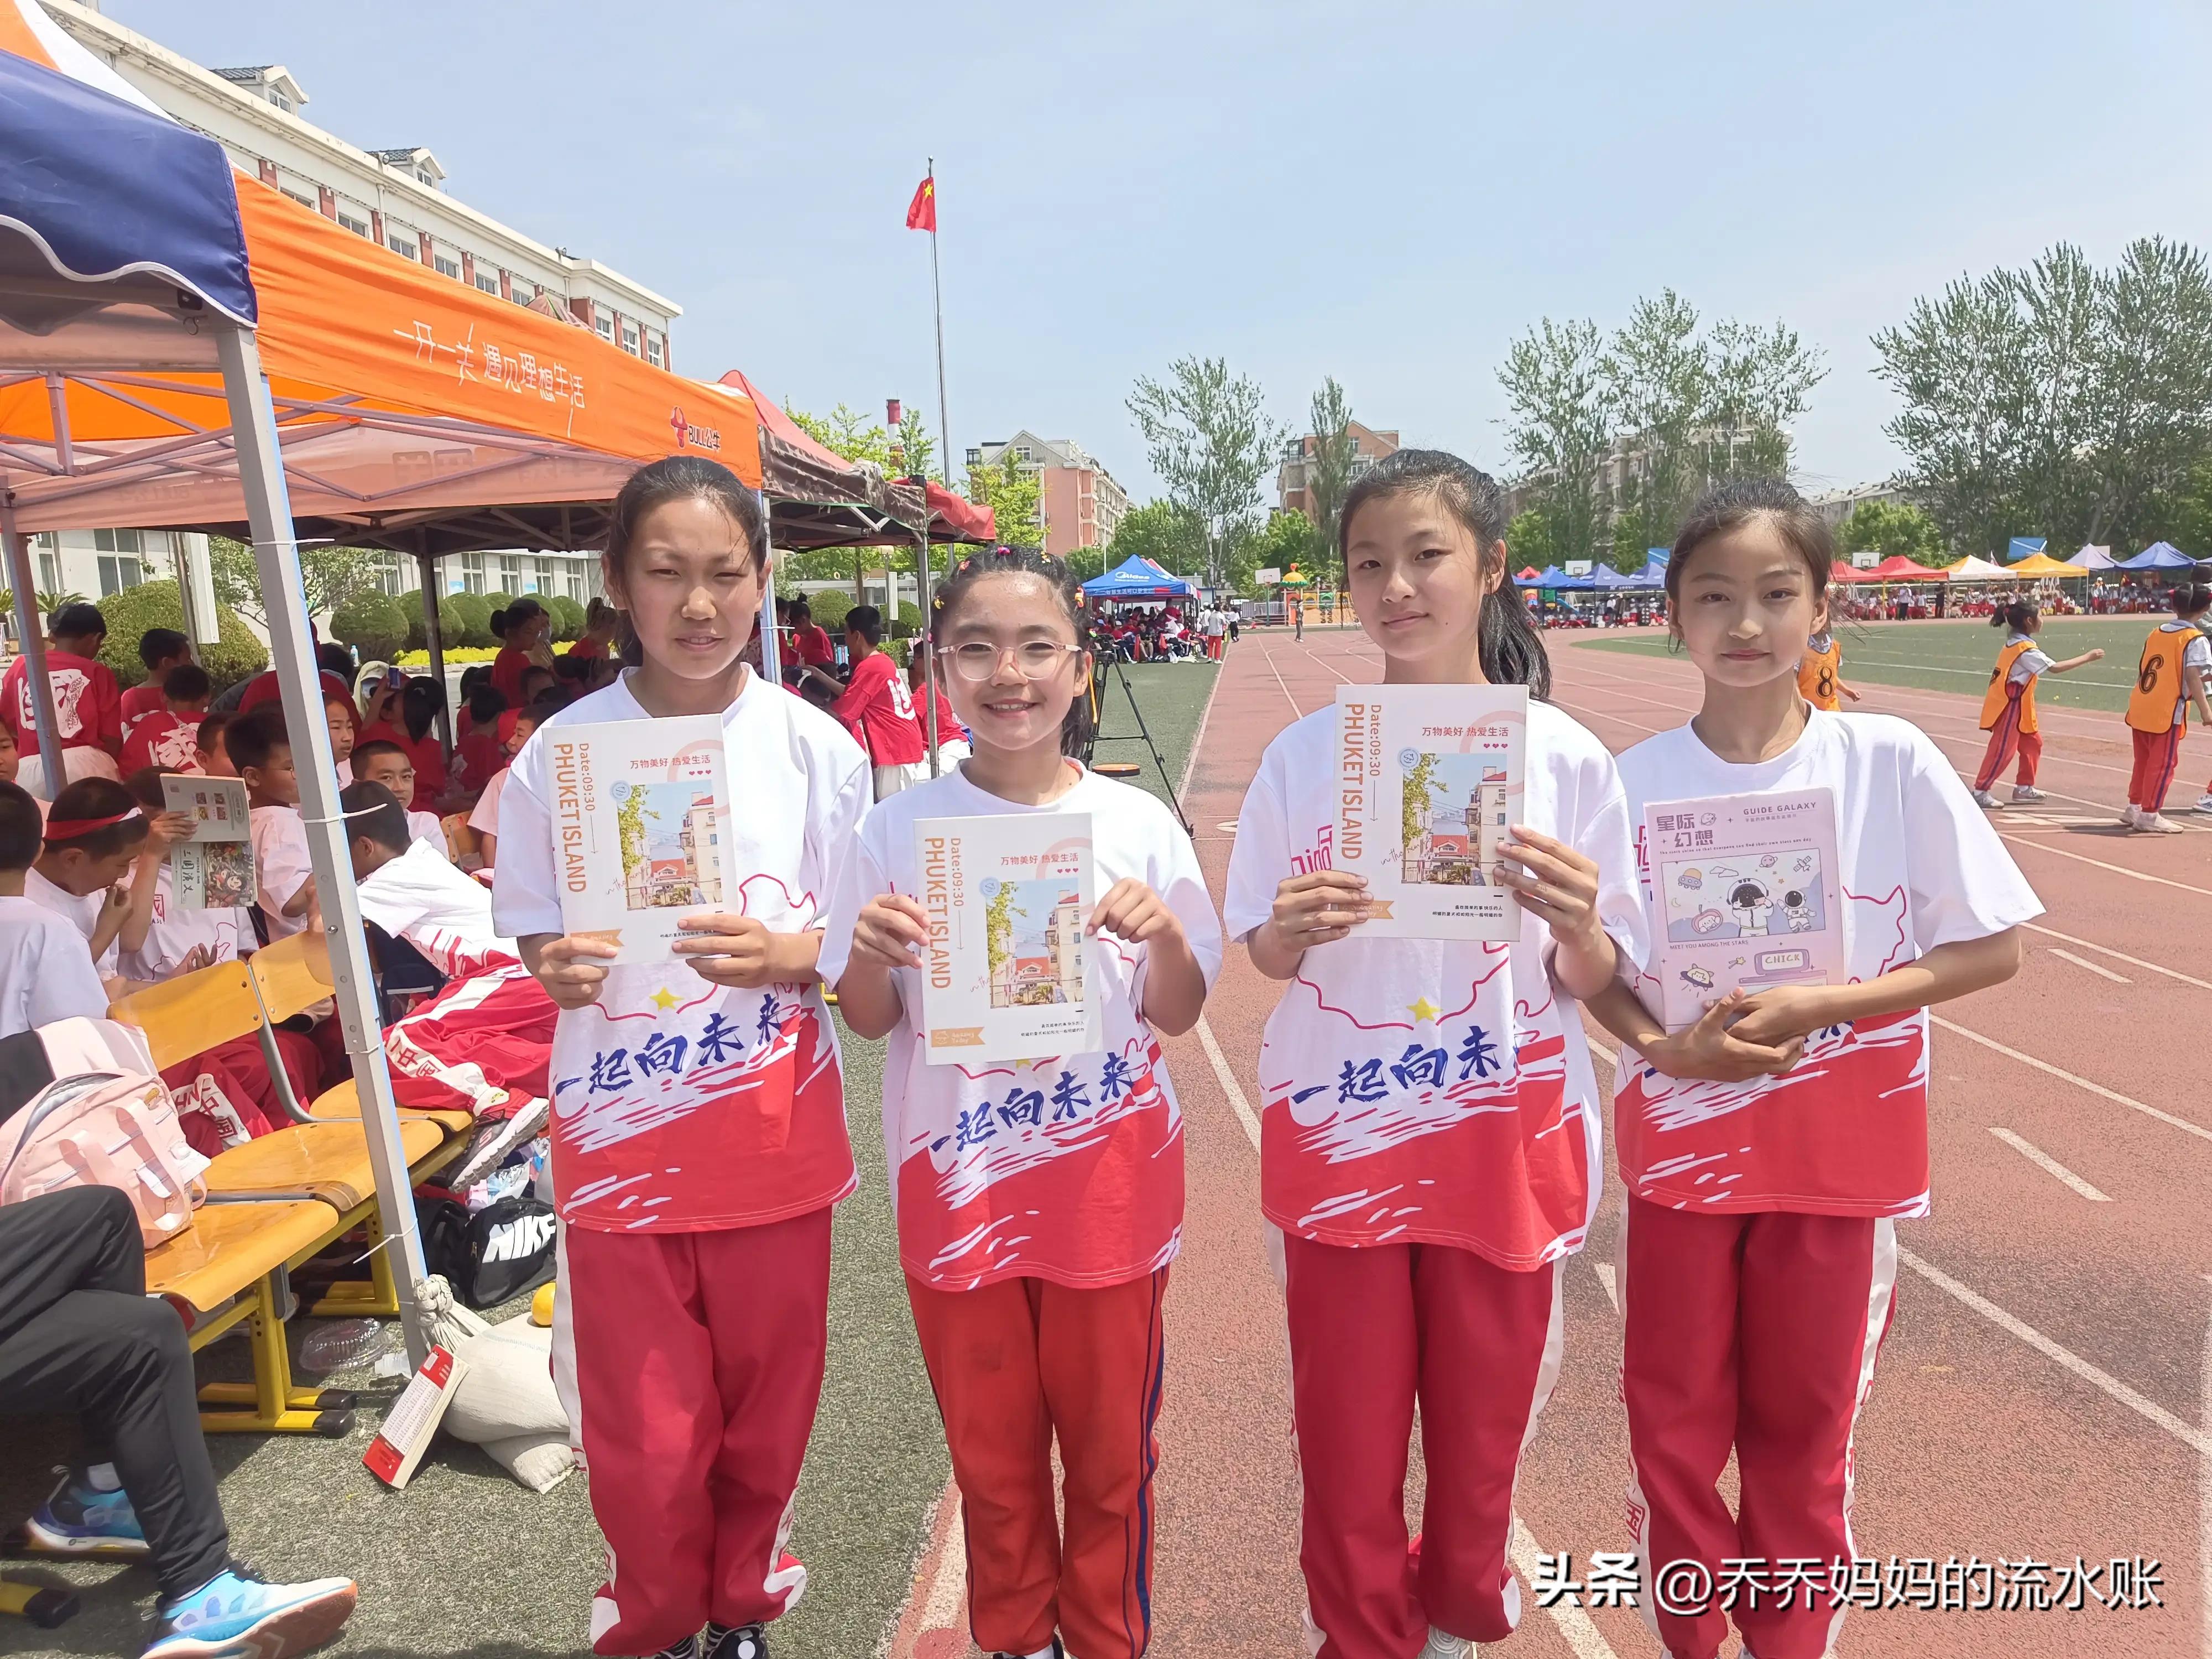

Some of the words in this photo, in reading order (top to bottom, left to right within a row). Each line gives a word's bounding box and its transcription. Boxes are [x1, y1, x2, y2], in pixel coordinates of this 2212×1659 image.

[393, 320, 479, 386] 一开一关
[482, 341, 585, 437] 遇见理想生活
[1815, 665, 1834, 698] 8
[2138, 654, 2163, 695] 6
[630, 758, 669, 769] 万物美好
[672, 755, 711, 765] 热爱生活
[1343, 704, 1364, 785] PHUKET
[1369, 705, 1381, 776] Date:09:30
[1422, 726, 1463, 737] 万物美好
[1467, 726, 1509, 737] 热爱生活
[554, 743, 580, 821] PHUKET
[579, 743, 596, 811] Date:09:30
[1743, 806, 1773, 816] GUIDE
[1777, 801, 1817, 812] GALAXY
[1341, 789, 1363, 859] ISLAND
[1656, 813, 1695, 832] 星际
[1674, 830, 1714, 848] 幻想
[562, 825, 587, 893] ISLAND
[925, 838, 948, 916] PHUKET
[951, 838, 964, 906] Date:09:30
[1000, 854, 1039, 866] 万物美好
[1041, 852, 1079, 863] 热爱生活
[929, 921, 951, 989] ISLAND
[1765, 953, 1801, 964] CHICK
[555, 993, 783, 1096] 一起向未来
[1291, 1025, 1519, 1104] 一起向未
[930, 1052, 1136, 1152] 一起向未来
[482, 1212, 556, 1264] NIKE
